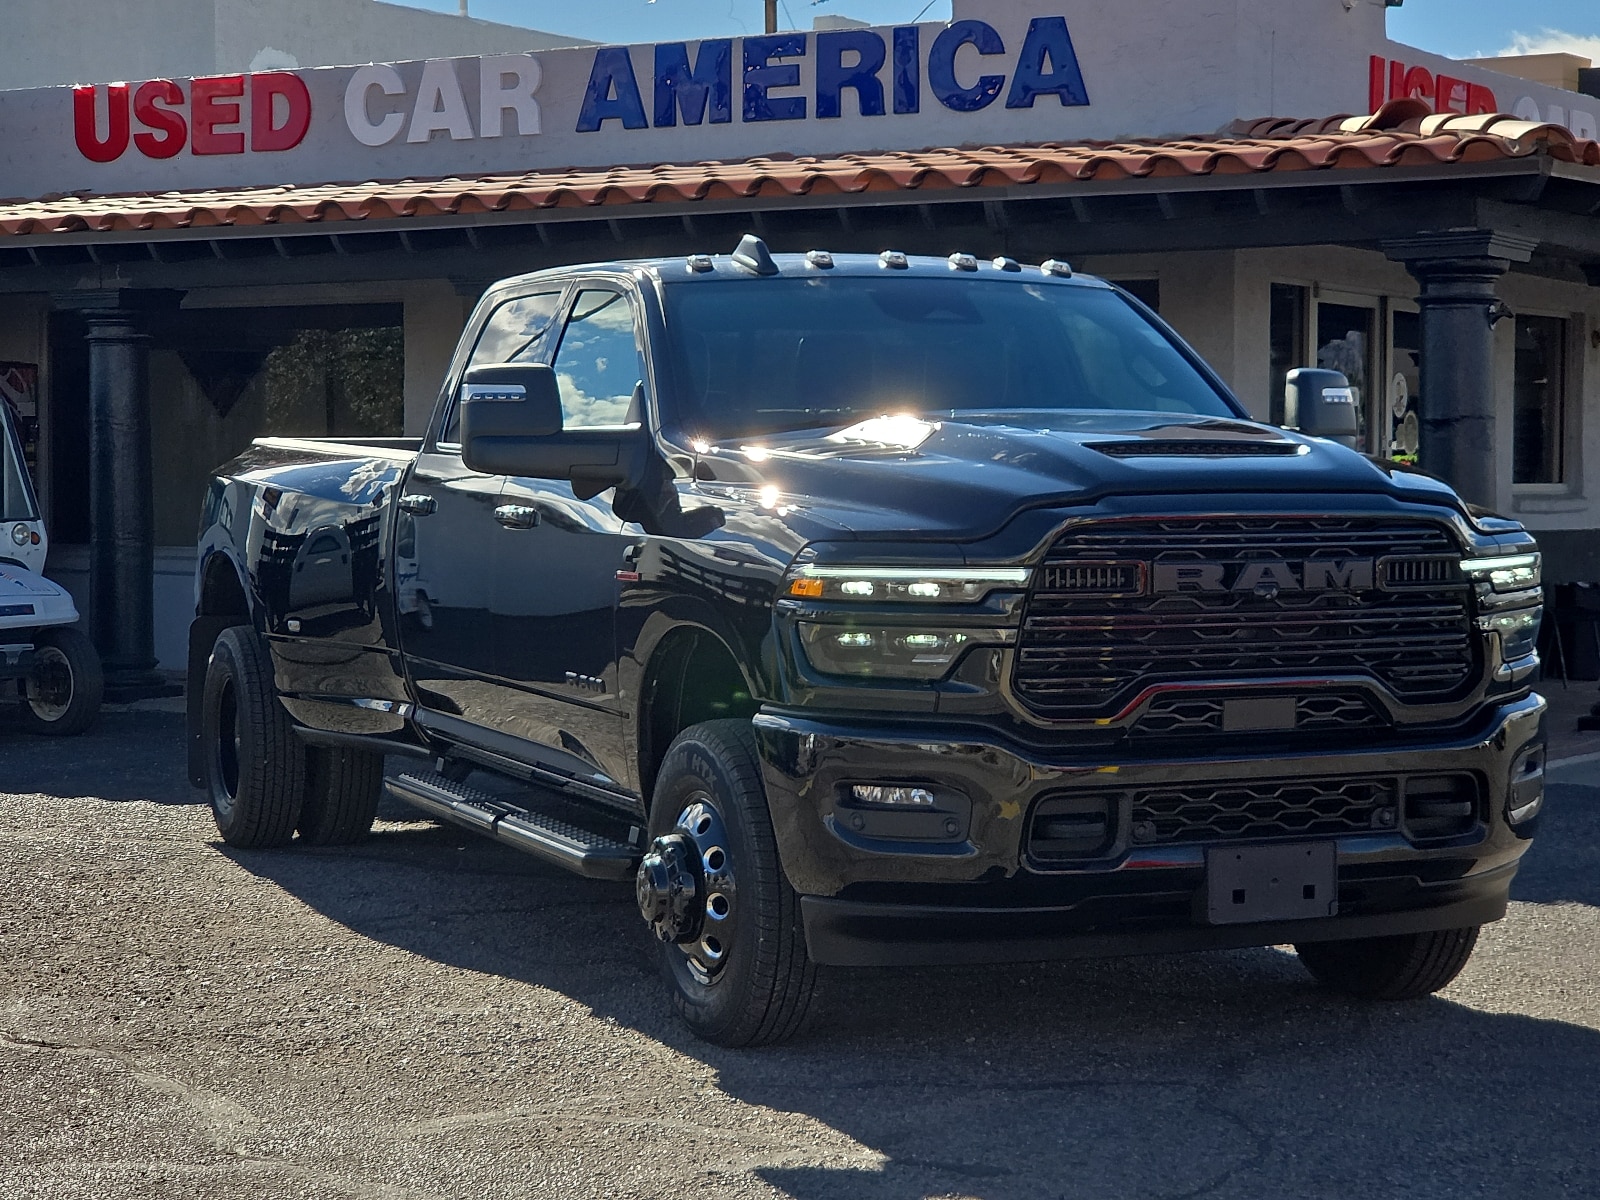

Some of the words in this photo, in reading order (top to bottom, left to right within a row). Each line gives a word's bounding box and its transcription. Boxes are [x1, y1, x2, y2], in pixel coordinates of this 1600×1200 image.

[73, 71, 312, 163] USED
[344, 53, 543, 147] CAR
[575, 16, 1091, 134] AMERICA
[1153, 557, 1374, 593] RAM
